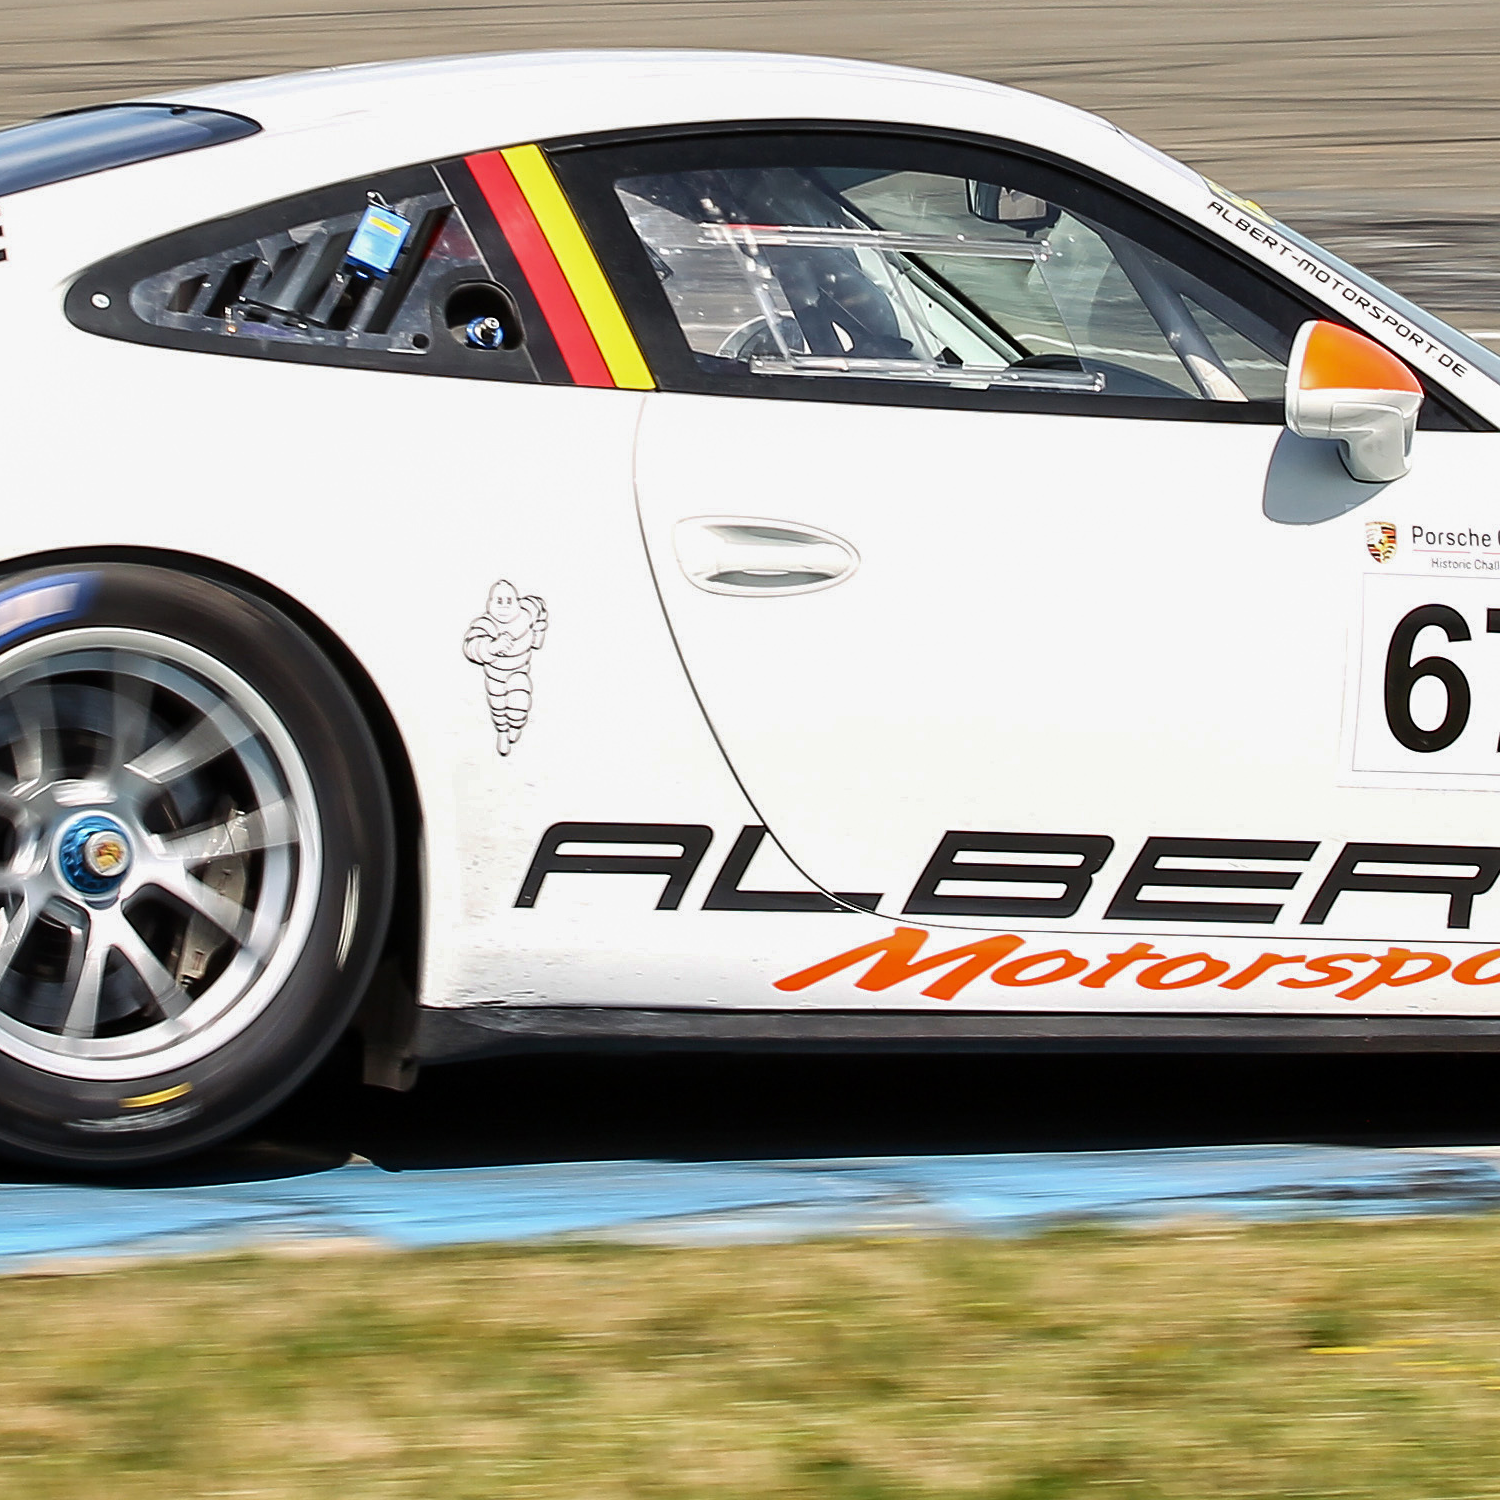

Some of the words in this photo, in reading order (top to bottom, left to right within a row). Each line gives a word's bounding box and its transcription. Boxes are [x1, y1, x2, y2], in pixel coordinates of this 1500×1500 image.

[1207, 201, 1468, 378] ALBERT-MOTORSPORT.DE
[1412, 526, 1491, 547] Porsche
[1432, 558, 1472, 570] Historic
